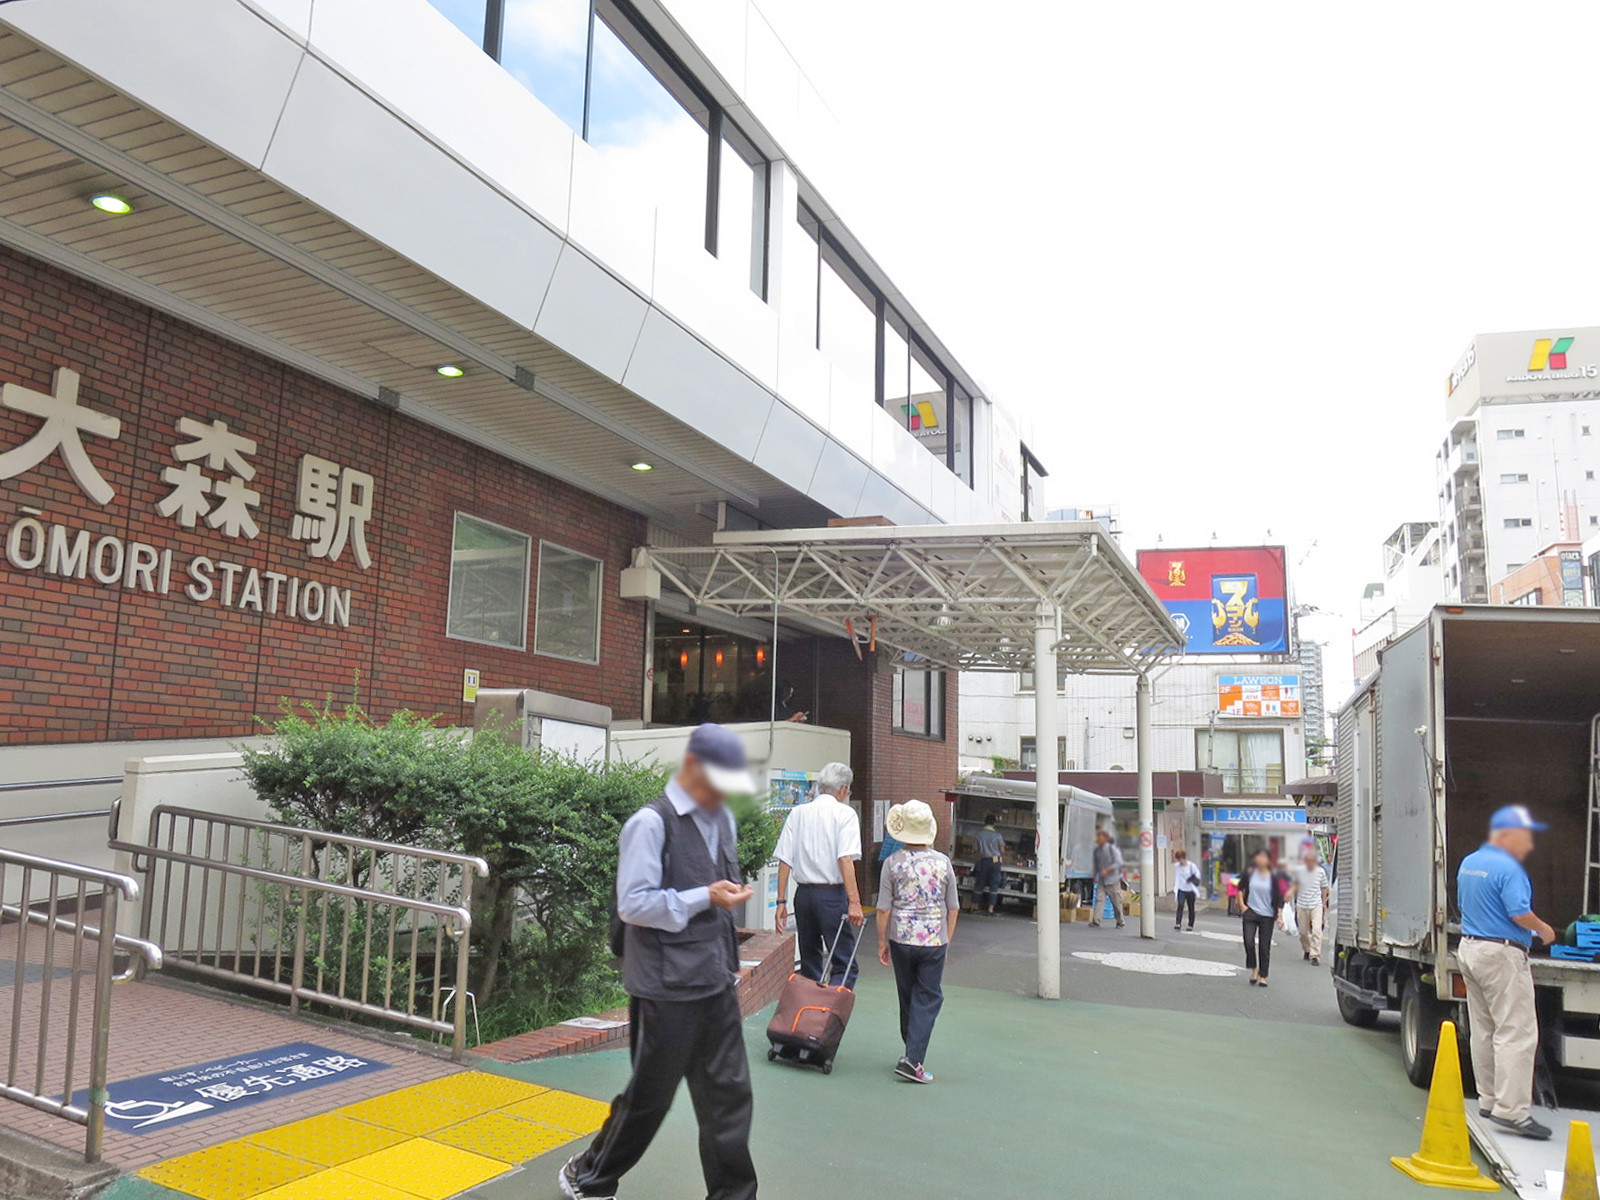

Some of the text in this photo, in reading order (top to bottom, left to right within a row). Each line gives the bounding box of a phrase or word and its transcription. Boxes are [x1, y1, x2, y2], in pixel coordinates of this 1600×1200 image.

[0, 366, 374, 570] 大森駅
[184, 556, 351, 628] STATION
[1233, 676, 1283, 684] LAWSON
[1227, 810, 1295, 822] LAWSON
[194, 1055, 368, 1102] 優先通路
